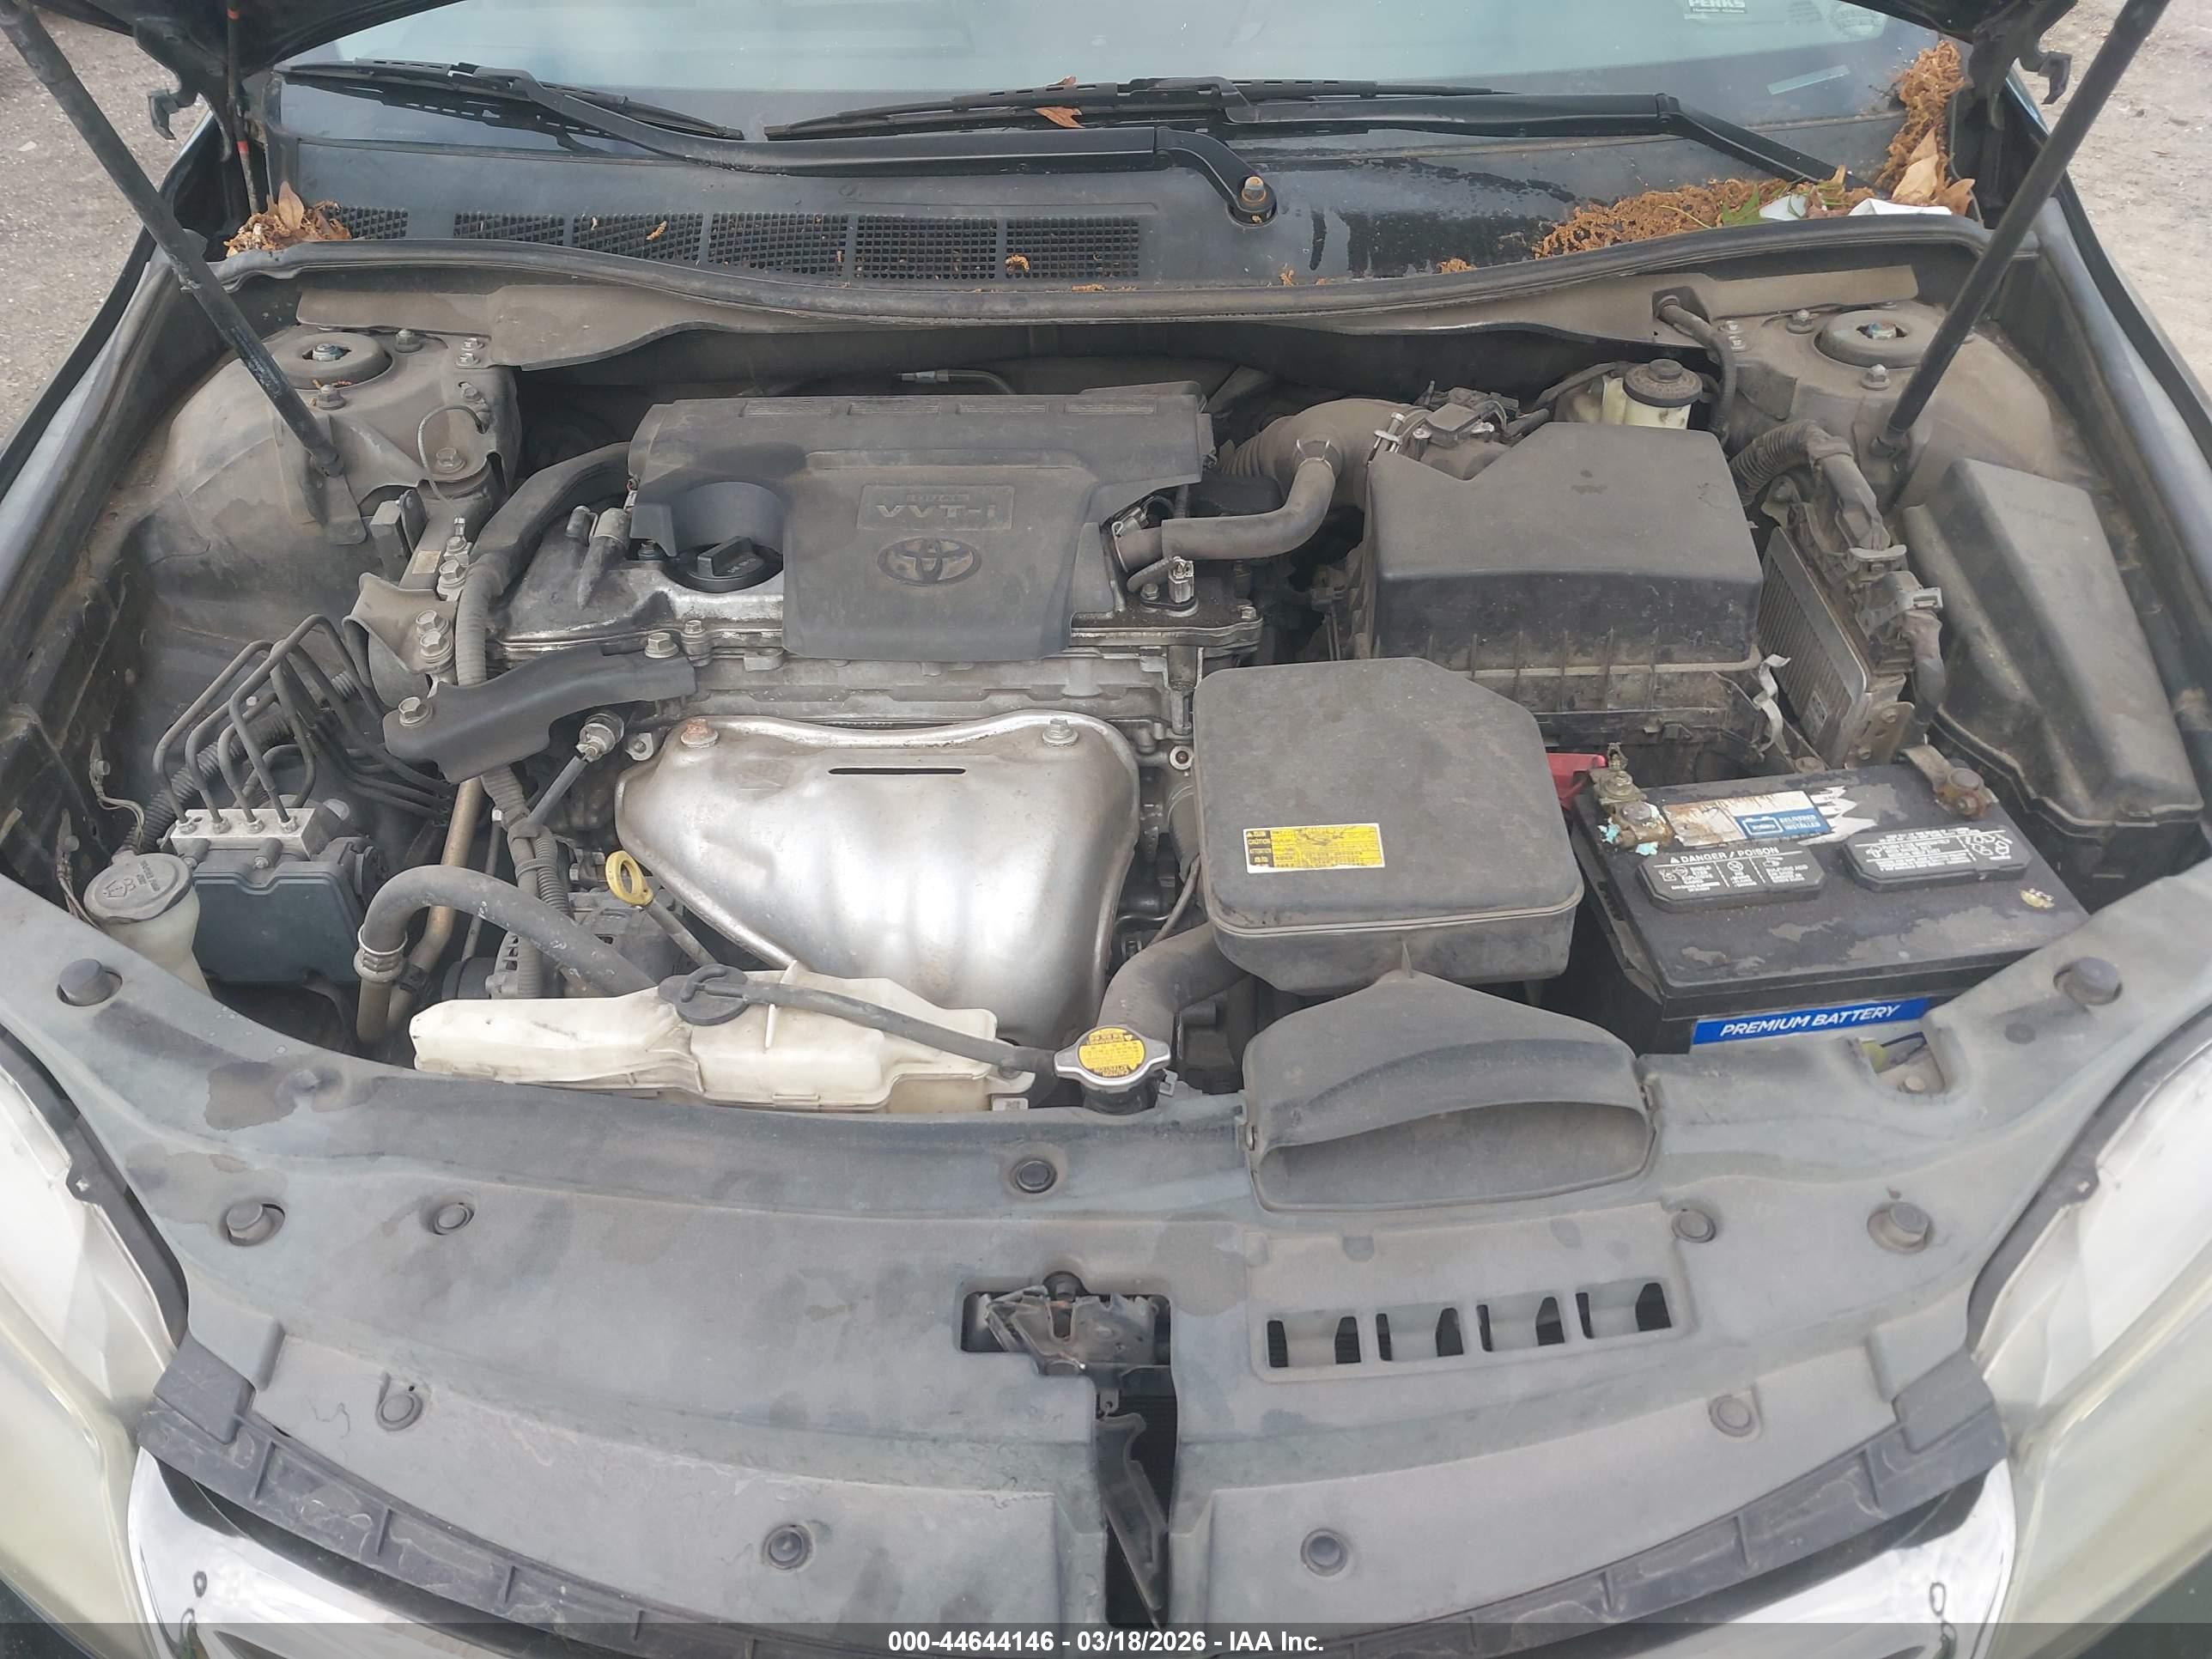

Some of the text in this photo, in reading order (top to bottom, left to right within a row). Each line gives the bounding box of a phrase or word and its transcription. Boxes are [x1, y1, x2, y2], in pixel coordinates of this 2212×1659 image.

[1680, 851, 1726, 863] DANGER
[1737, 847, 1780, 857] POISON
[1720, 1005, 1900, 1036] PREMIUM BATTERY
